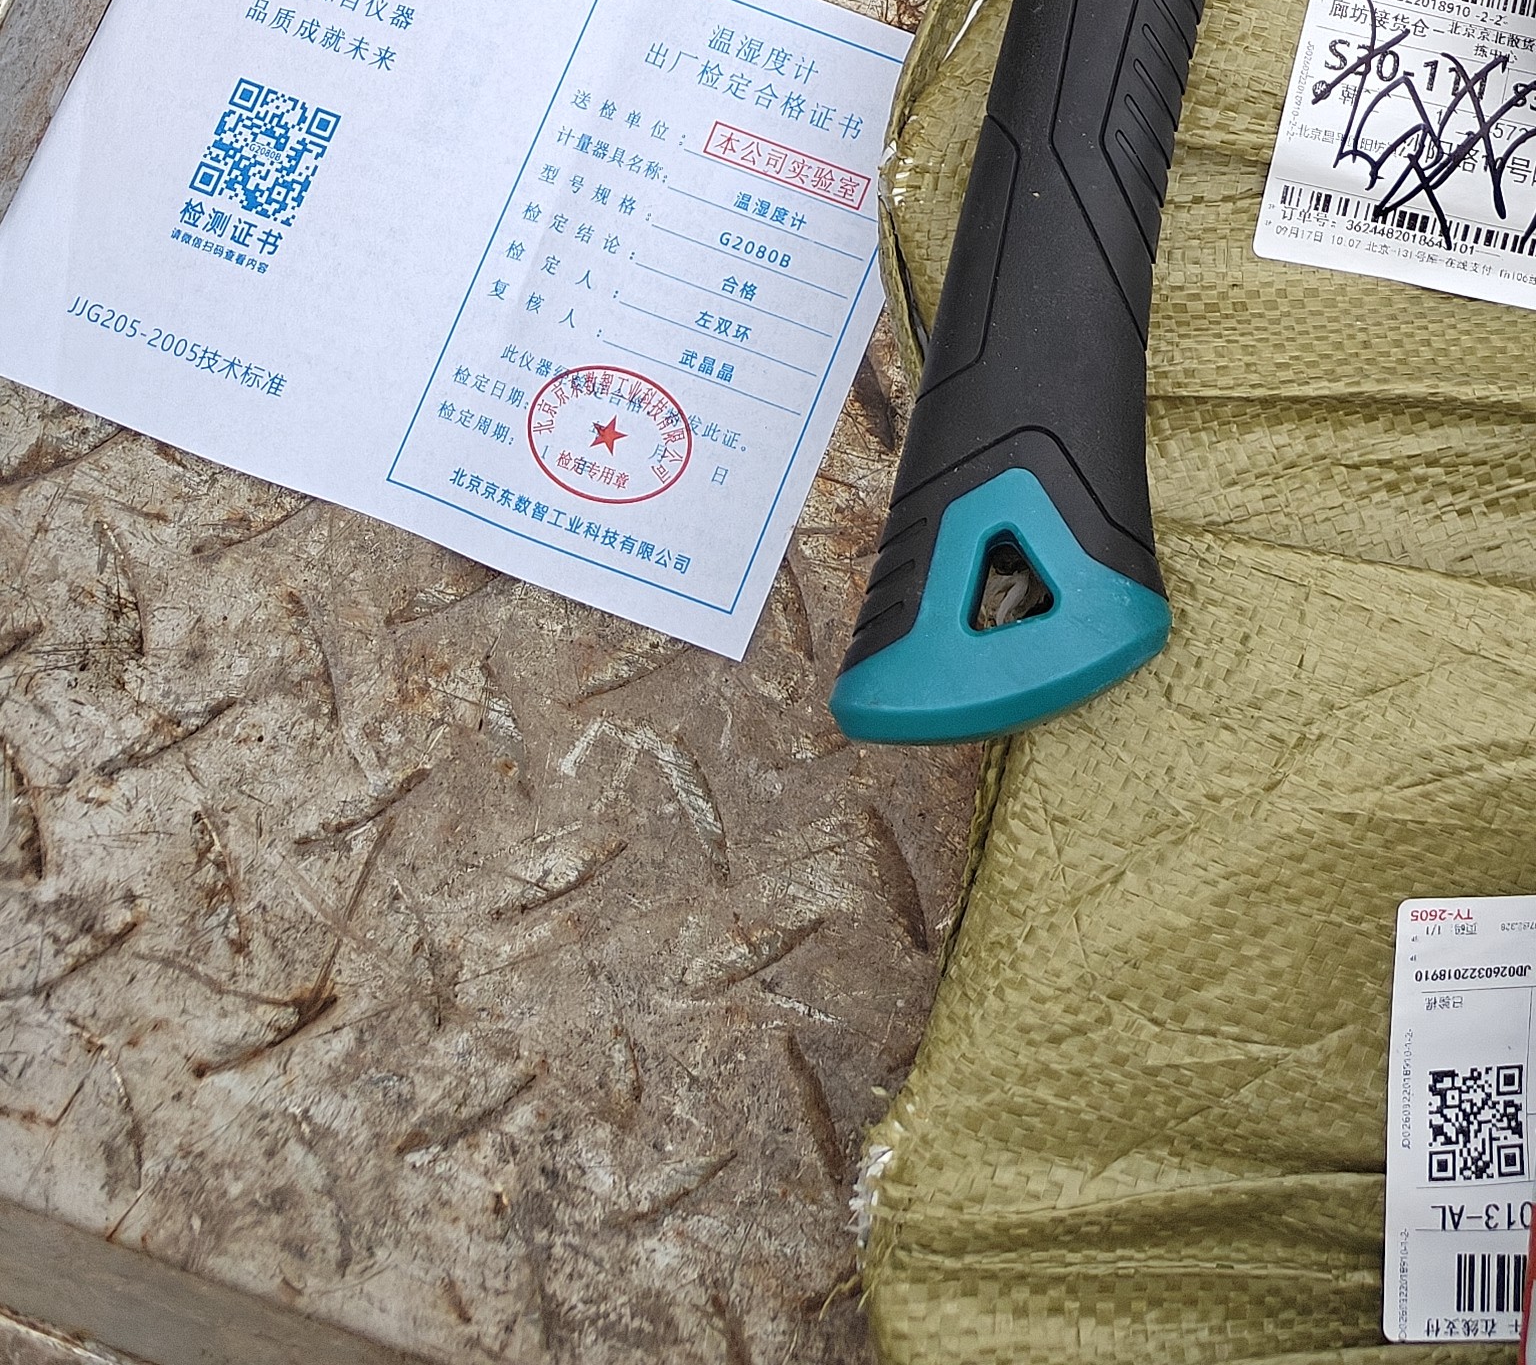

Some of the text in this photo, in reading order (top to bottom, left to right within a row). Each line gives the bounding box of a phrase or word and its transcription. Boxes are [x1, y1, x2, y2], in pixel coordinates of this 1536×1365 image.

[708, 25, 818, 84] 温湿度计
[645, 43, 863, 139] 出厂检定合格证书
[248, 140, 283, 163] G2080B
[715, 133, 860, 202] 本公司实验室
[180, 198, 283, 255] 检测证书
[734, 192, 806, 230] 温湿度计
[171, 228, 269, 274] 请微信扫码查看内容
[720, 232, 791, 268] G2080B
[722, 276, 757, 301] 合格
[695, 311, 752, 342] 左双环
[67, 297, 287, 397] JJG205-2005技术标准
[679, 350, 734, 382] 武晶晶
[711, 466, 728, 485] 日
[448, 465, 692, 577] 北京京东数智工业科技有限公司
[1411, 909, 1473, 921] TY-2605
[1415, 965, 1531, 982] JD0260322018910
